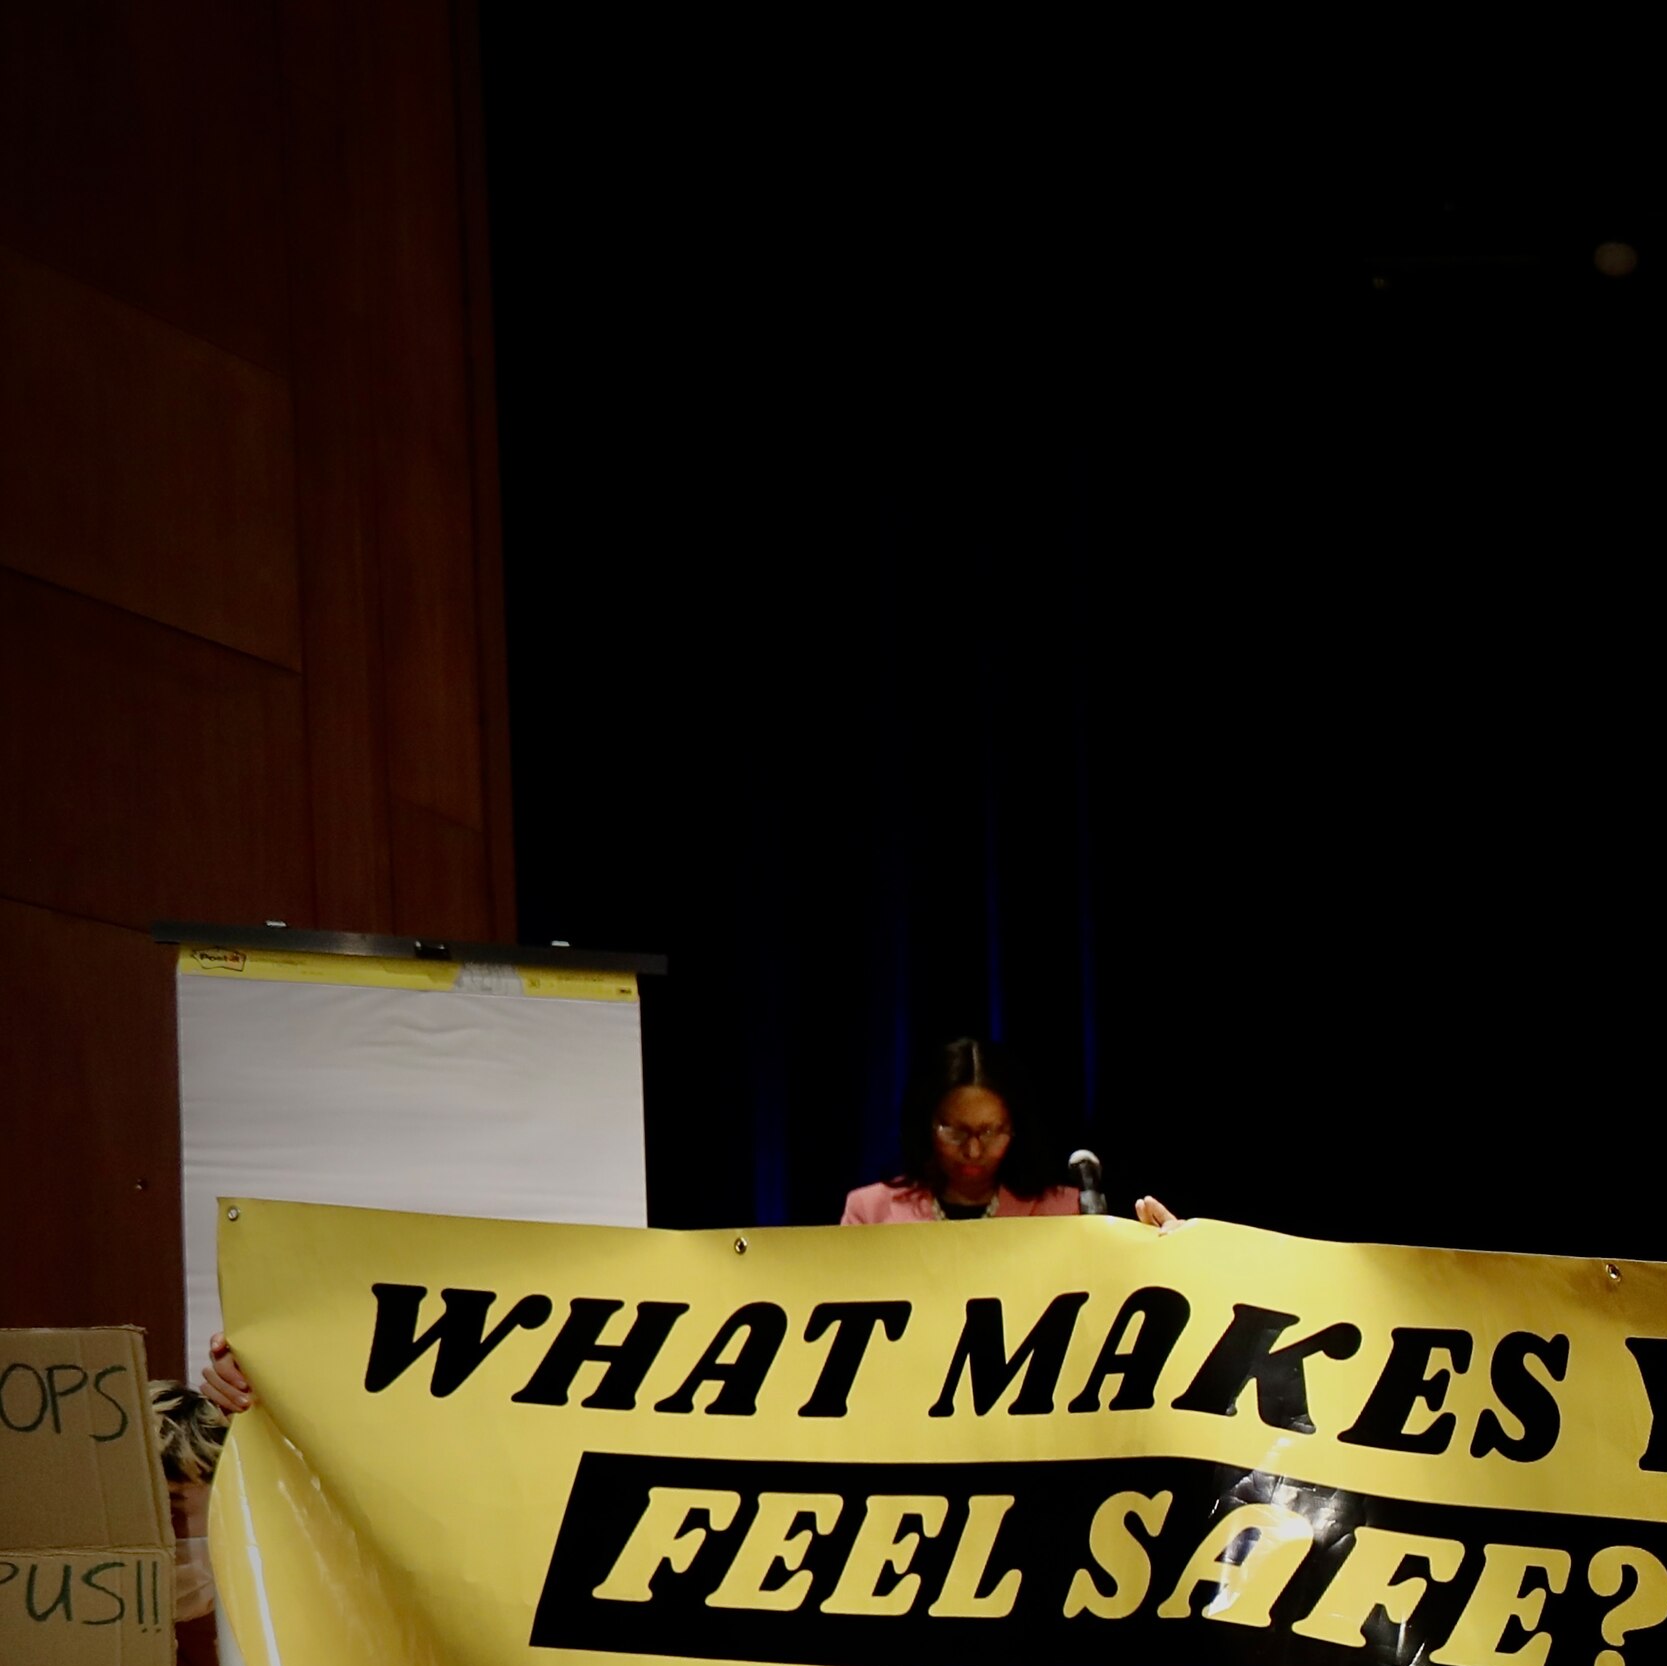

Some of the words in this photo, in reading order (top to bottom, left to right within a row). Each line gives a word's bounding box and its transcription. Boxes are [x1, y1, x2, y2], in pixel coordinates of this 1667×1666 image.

[364, 1282, 912, 1418] WHAT
[928, 1286, 1570, 1464] MAKES
[591, 1486, 1024, 1619] FEEL
